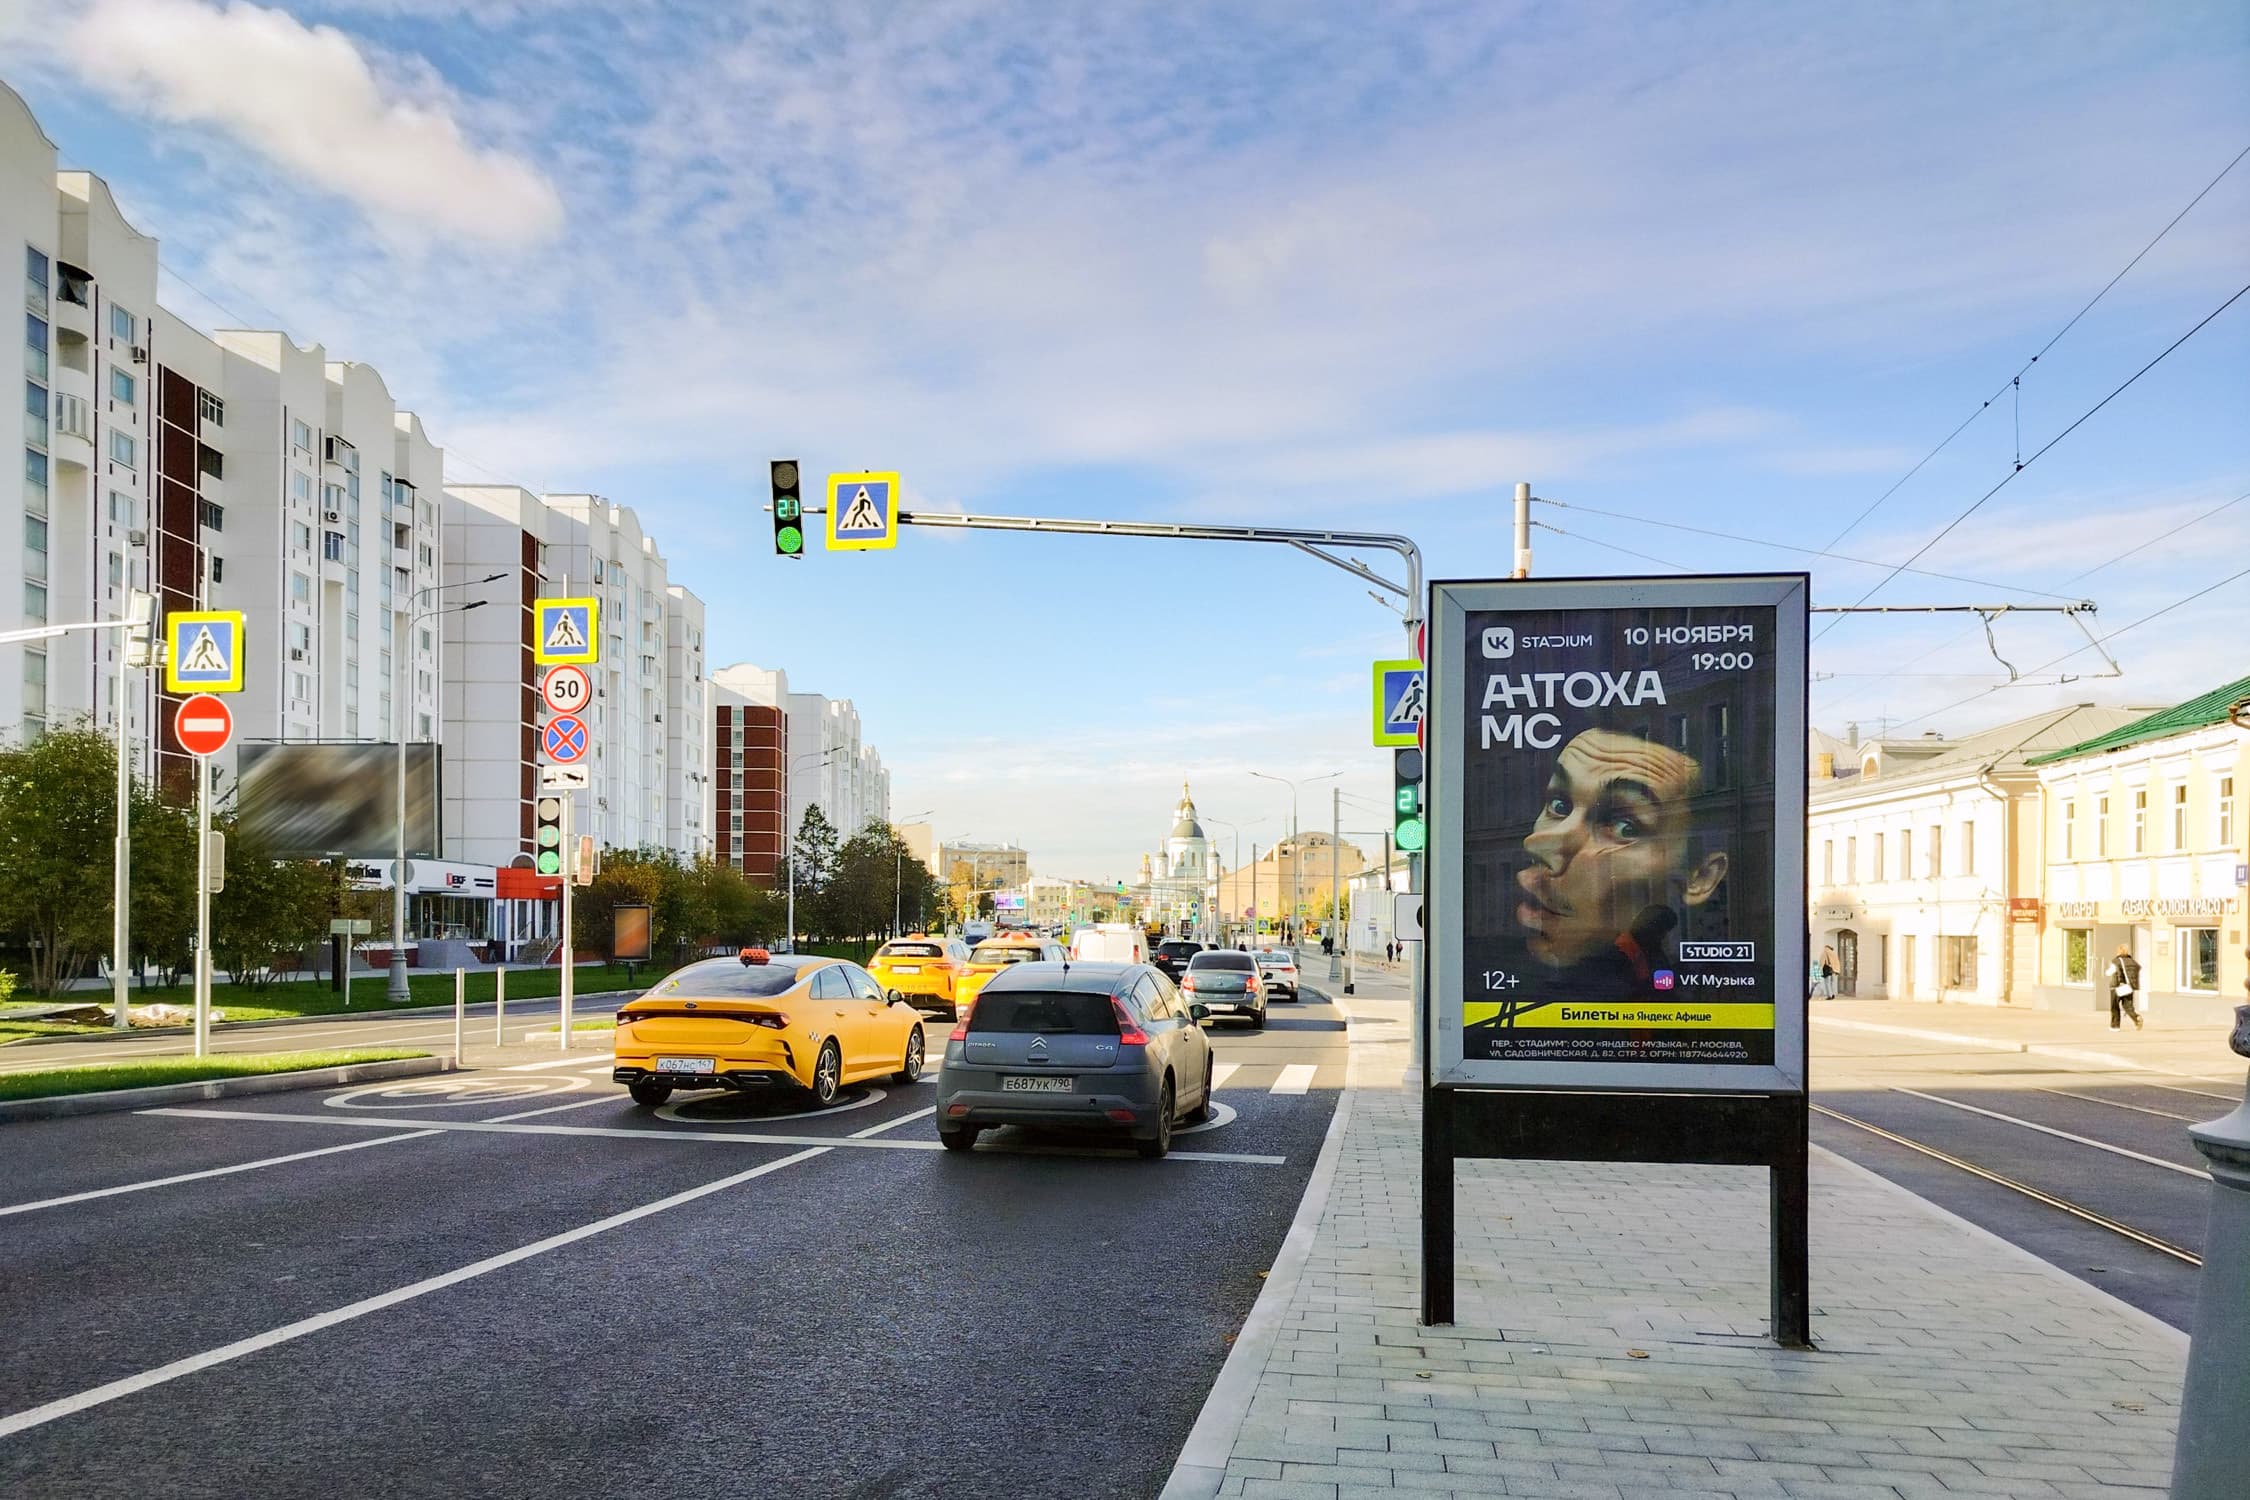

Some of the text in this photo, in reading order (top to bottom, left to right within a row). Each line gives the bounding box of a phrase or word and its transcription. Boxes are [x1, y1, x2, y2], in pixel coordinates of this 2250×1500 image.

[1522, 634, 1593, 648] STADIUM
[1624, 625, 1754, 645] 10 НОЯБРЯ
[1691, 652, 1754, 671] 19:00
[555, 680, 579, 699] 50
[1481, 670, 1667, 709] АНТОХА
[1686, 945, 1749, 958] STUDIO 21
[1482, 970, 1520, 990] 12+
[1680, 974, 1755, 988] VK Музыка
[1561, 1007, 1712, 1023] Билеты на Яндекс Афише
[1052, 1077, 1070, 1088] 790
